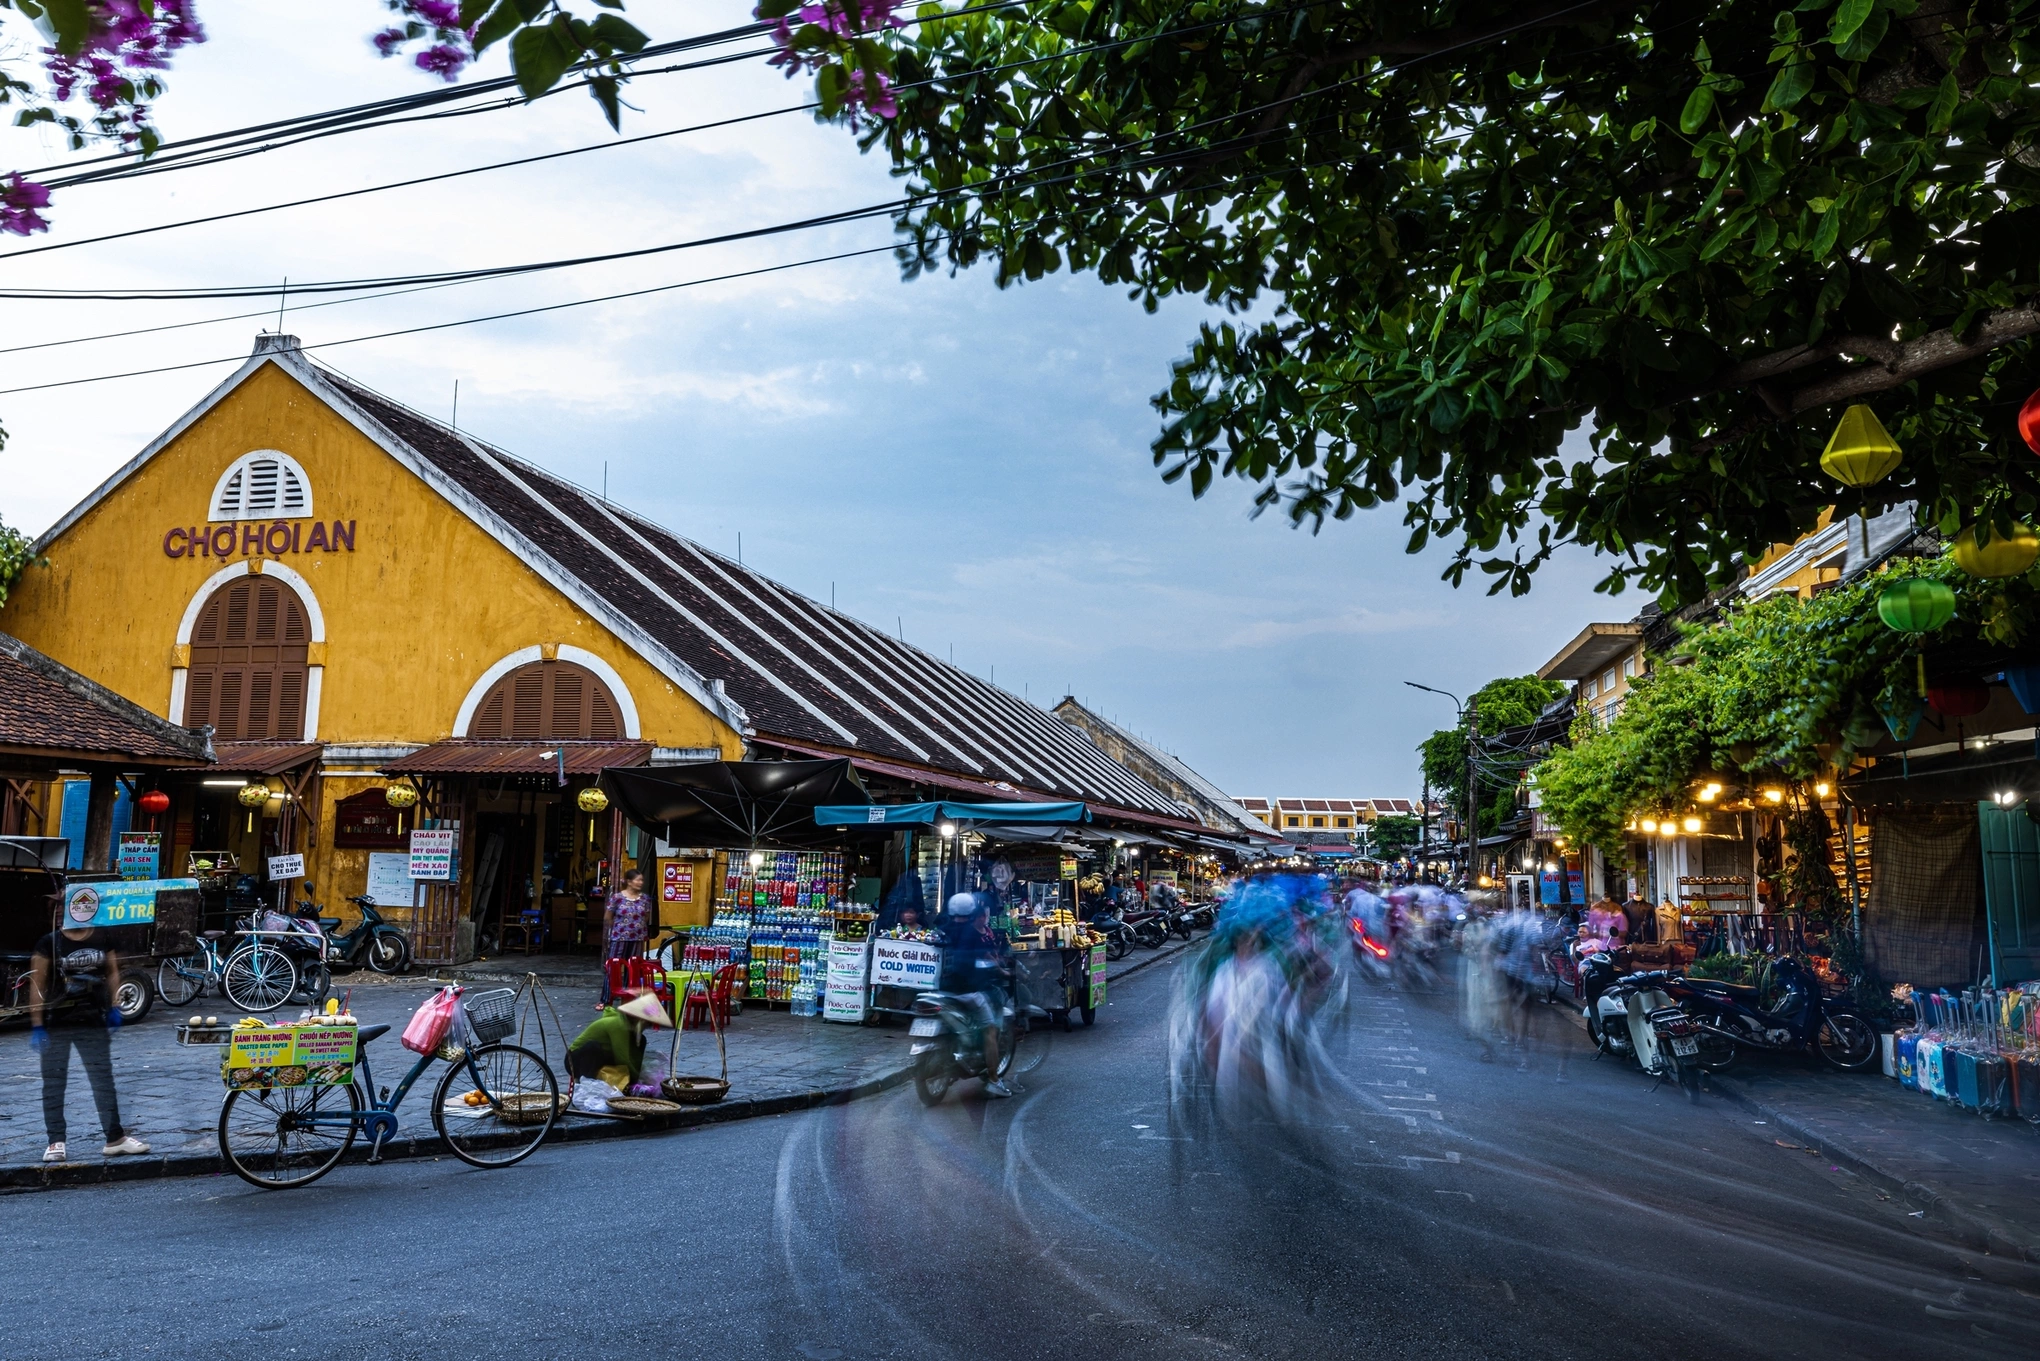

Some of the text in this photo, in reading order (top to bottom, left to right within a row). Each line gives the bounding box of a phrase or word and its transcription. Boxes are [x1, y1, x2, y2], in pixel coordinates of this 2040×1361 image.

[164, 518, 357, 563] CHỢ HỘI AN
[438, 832, 451, 840] VỊT
[271, 862, 285, 870] CHO
[106, 888, 122, 896] BAN
[107, 898, 155, 920] TỔ TRẬ
[920, 951, 940, 963] Khát
[834, 962, 845, 970] Trà
[880, 960, 936, 975] COLD WATER
[844, 983, 864, 991] Chanh
[845, 1001, 861, 1009] Cam
